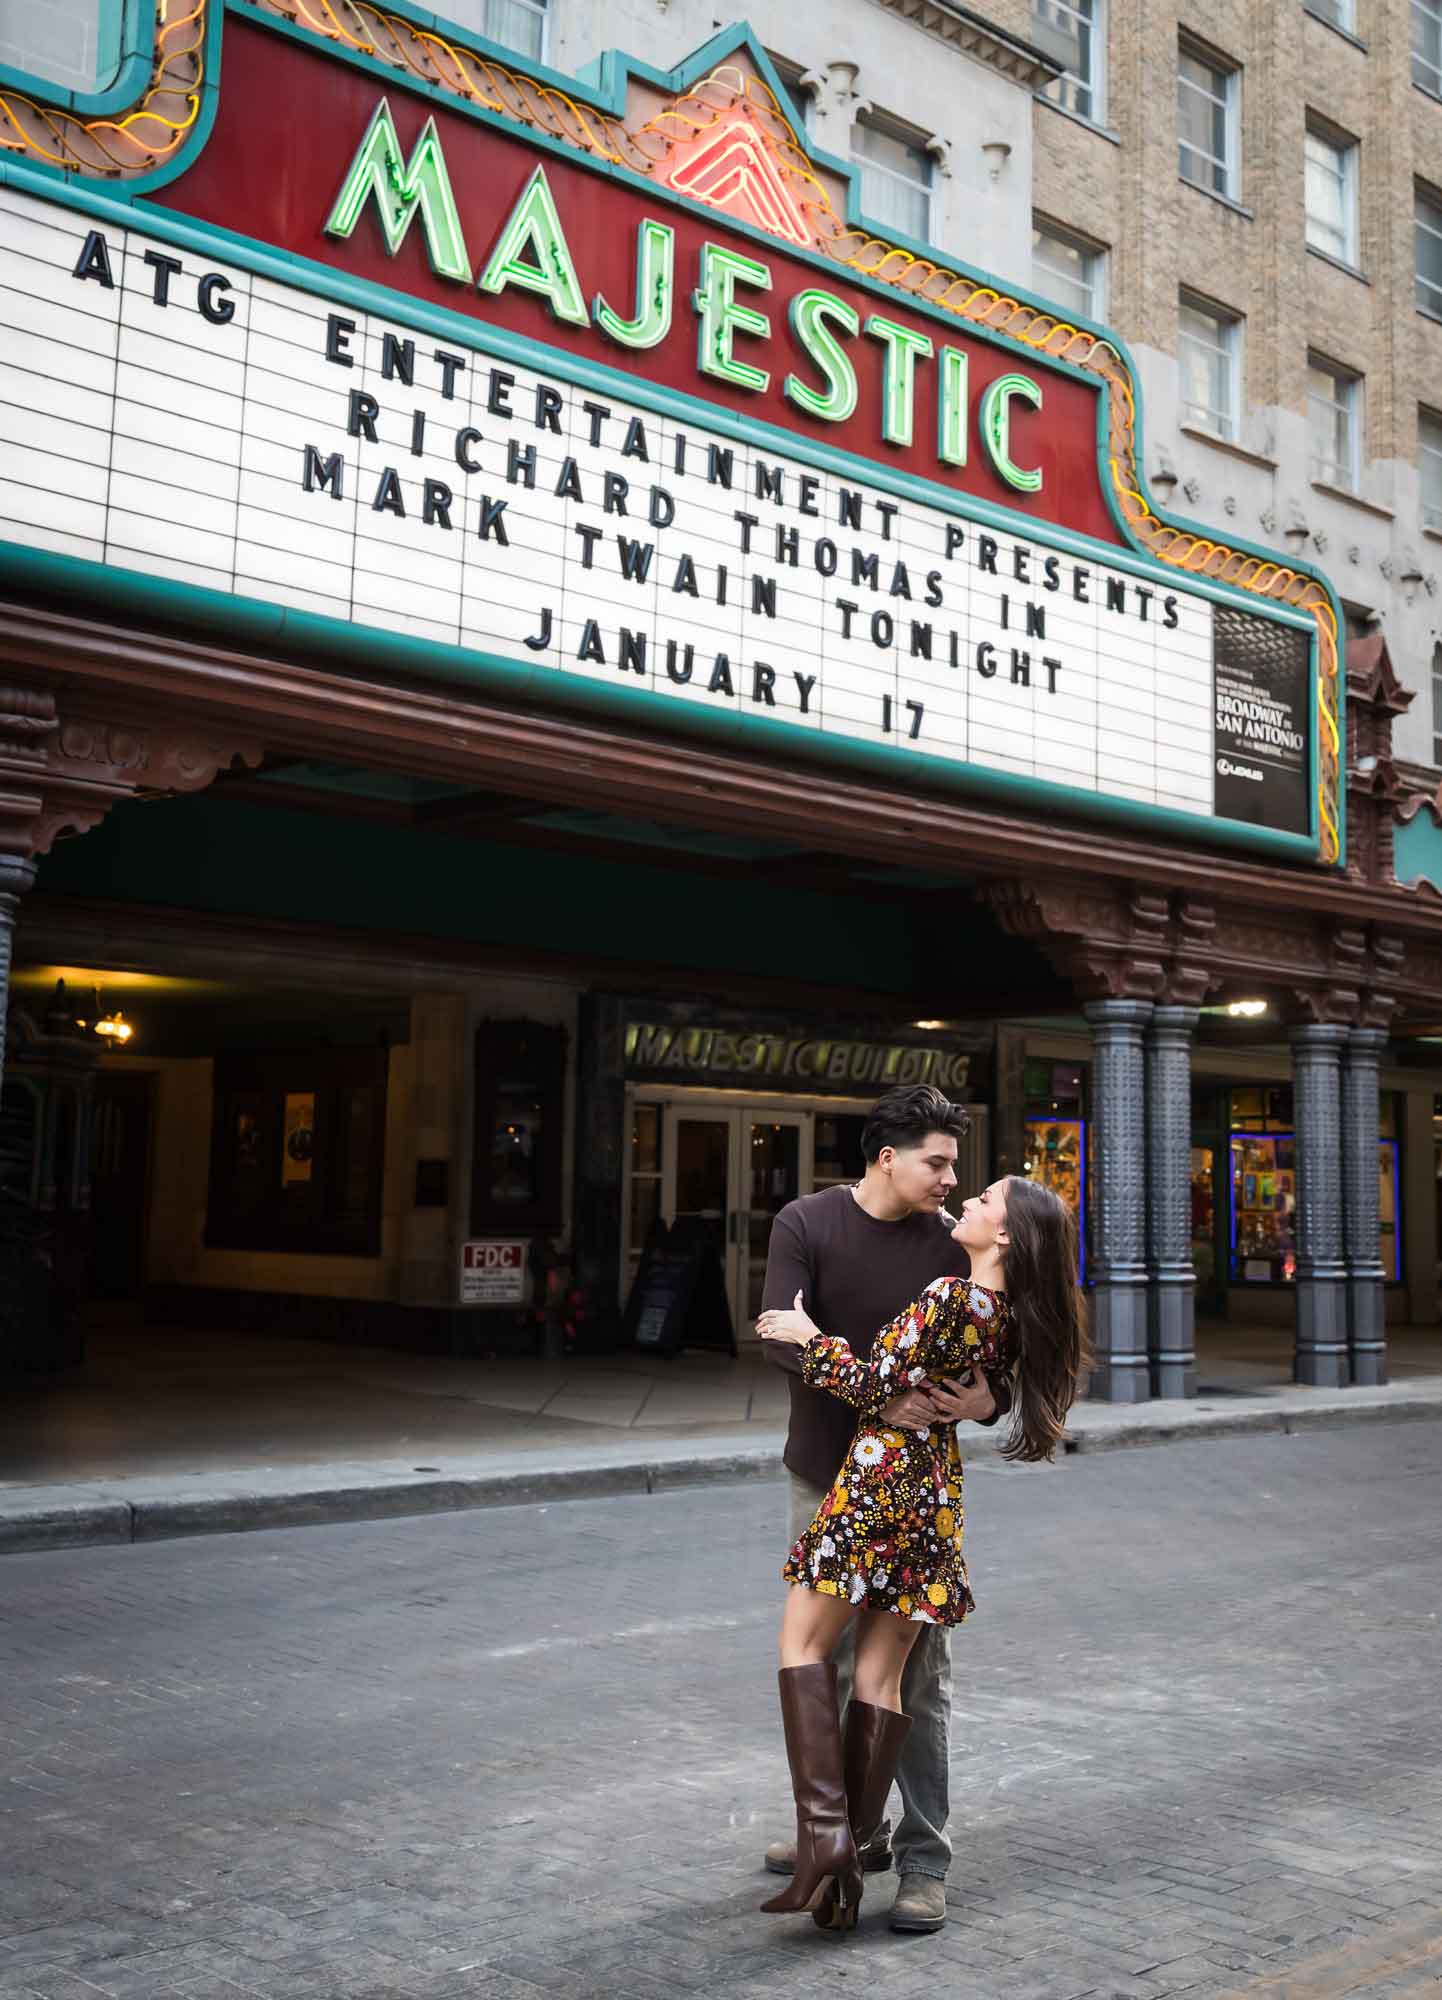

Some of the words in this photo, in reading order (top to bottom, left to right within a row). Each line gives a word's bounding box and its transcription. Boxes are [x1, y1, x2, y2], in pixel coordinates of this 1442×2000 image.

[323, 96, 1043, 493] MAJESTIC
[73, 230, 236, 325] ATG
[326, 313, 899, 541] ENTERTAINMENT
[943, 522, 1181, 629] PRESENTS
[302, 444, 511, 547] MARK
[575, 523, 777, 618] TWAIN
[835, 598, 1062, 695] TONIGHT
[348, 389, 675, 528] RICHARD
[734, 511, 943, 608] THOMAS
[1000, 594, 1046, 640] IN
[523, 608, 818, 714] JANUARY
[881, 695, 924, 740] 17
[1216, 694, 1284, 727] BROADWAY
[1216, 711, 1243, 734] SAN
[1244, 720, 1303, 751] ANTONIO
[634, 1025, 818, 1077] MAJESTIC
[826, 1042, 971, 1088] BUILDING
[473, 1247, 513, 1267] FDC
